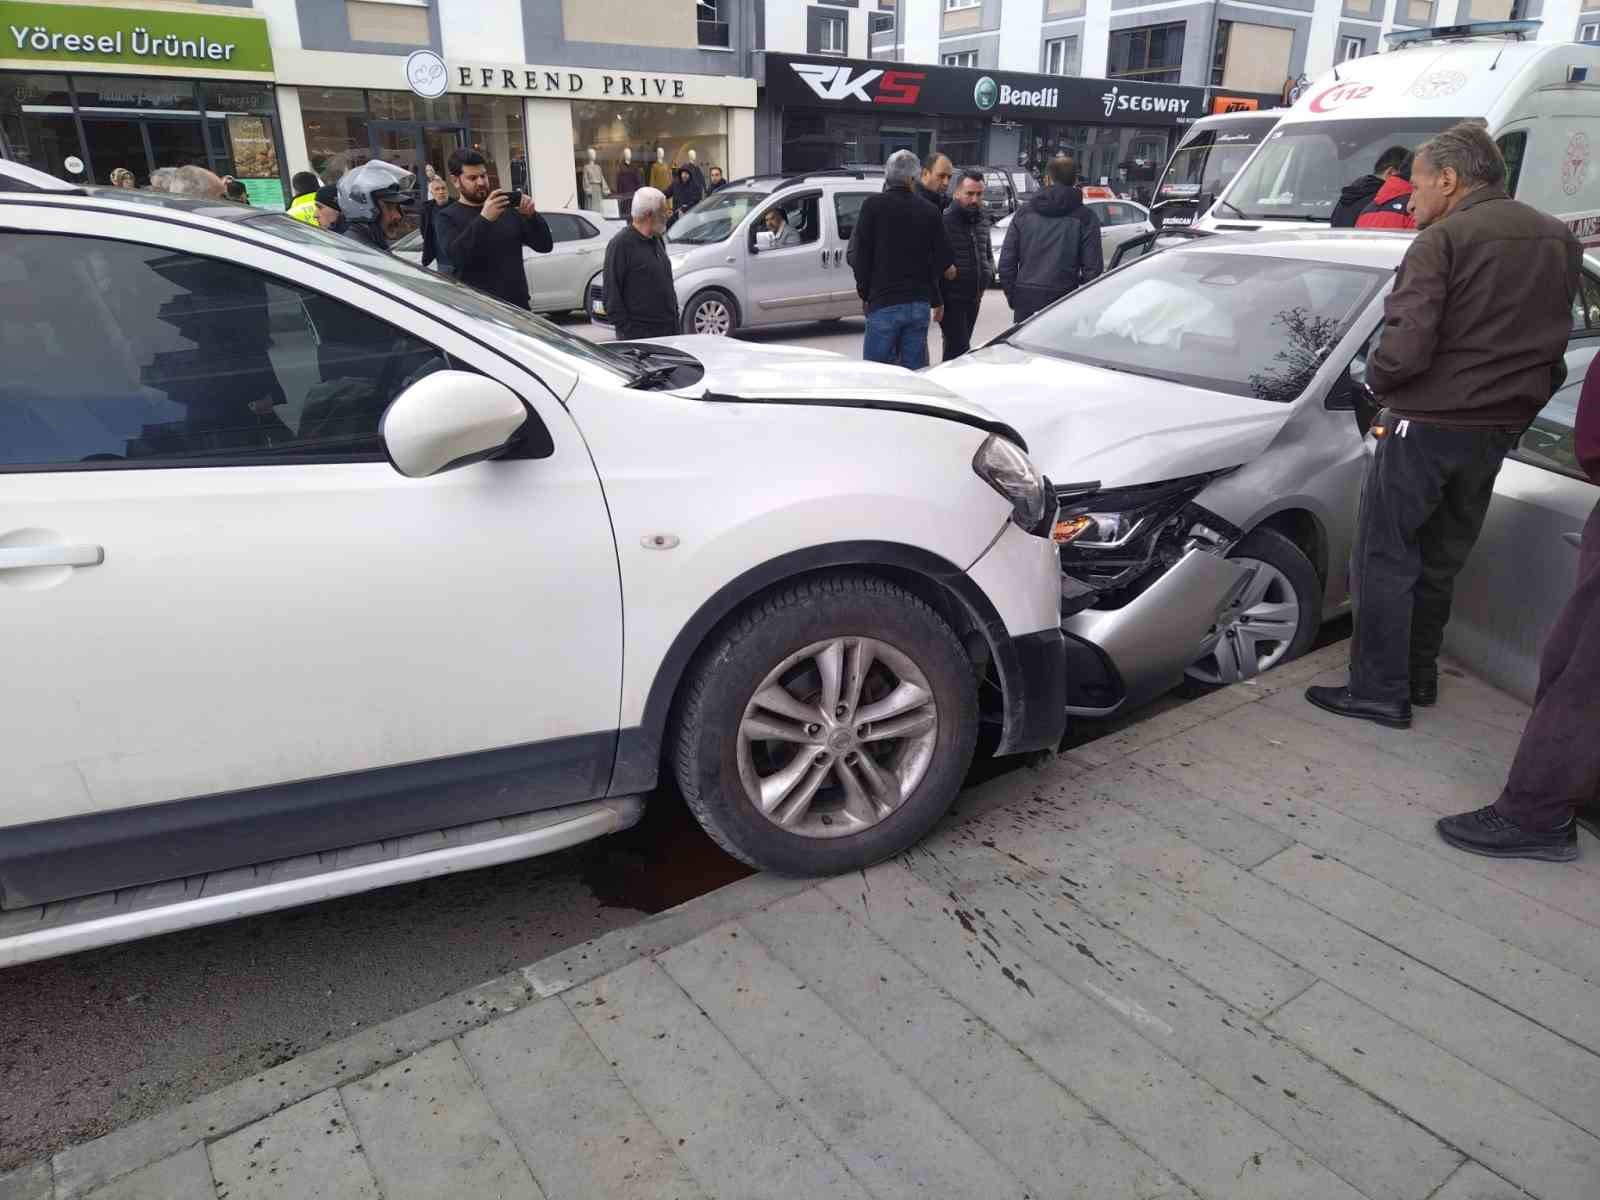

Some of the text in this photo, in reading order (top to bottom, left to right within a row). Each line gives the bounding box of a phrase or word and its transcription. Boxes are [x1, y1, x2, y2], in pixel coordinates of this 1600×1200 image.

[9, 25, 235, 60] Yöresel Ürünler
[458, 66, 685, 97] EFREND PRIVE
[999, 85, 1059, 108] Benelli
[1118, 95, 1190, 113] SEGWAY
[1332, 86, 1374, 102] 112
